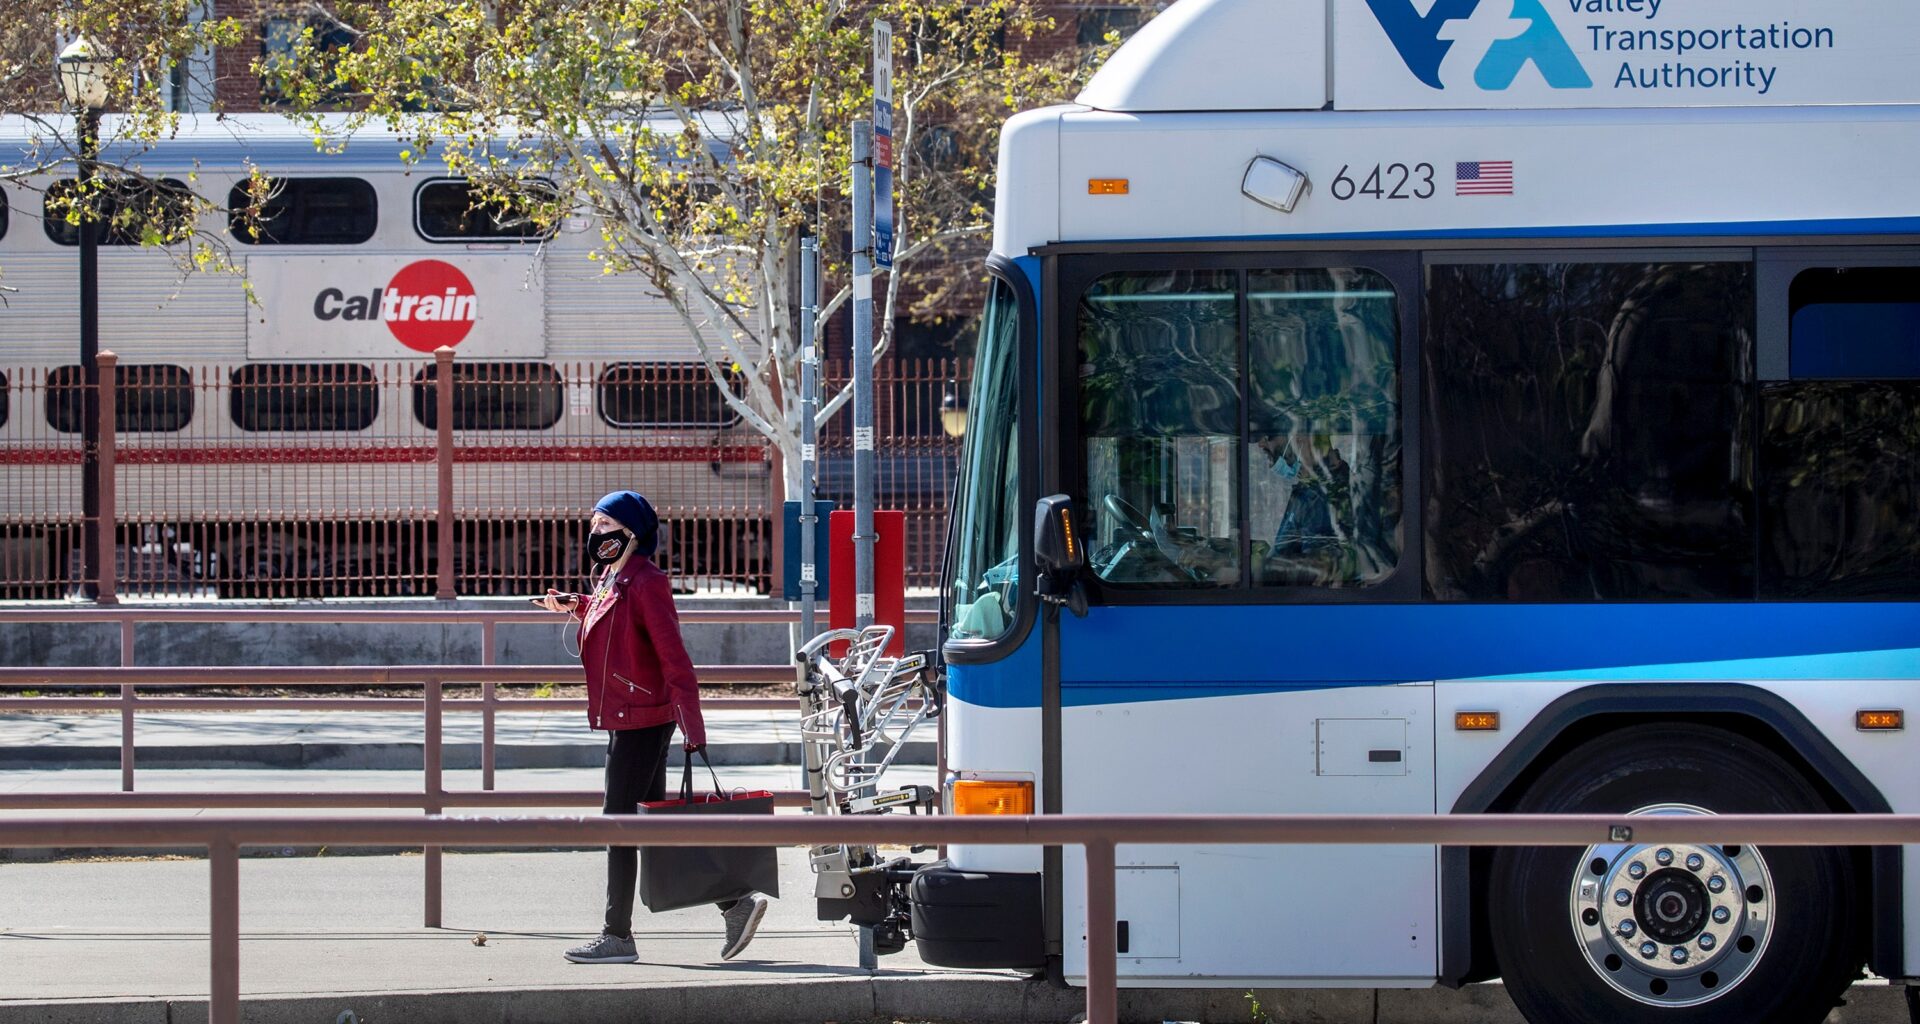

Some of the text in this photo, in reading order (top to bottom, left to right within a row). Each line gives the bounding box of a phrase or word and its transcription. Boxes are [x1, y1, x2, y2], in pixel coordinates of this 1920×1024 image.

[877, 29, 890, 62] BAY
[1587, 21, 1833, 55] Transportation
[880, 67, 888, 97] 10
[1614, 60, 1777, 94] Authority
[1331, 162, 1435, 201] 6423
[313, 287, 477, 322] Caltrain
